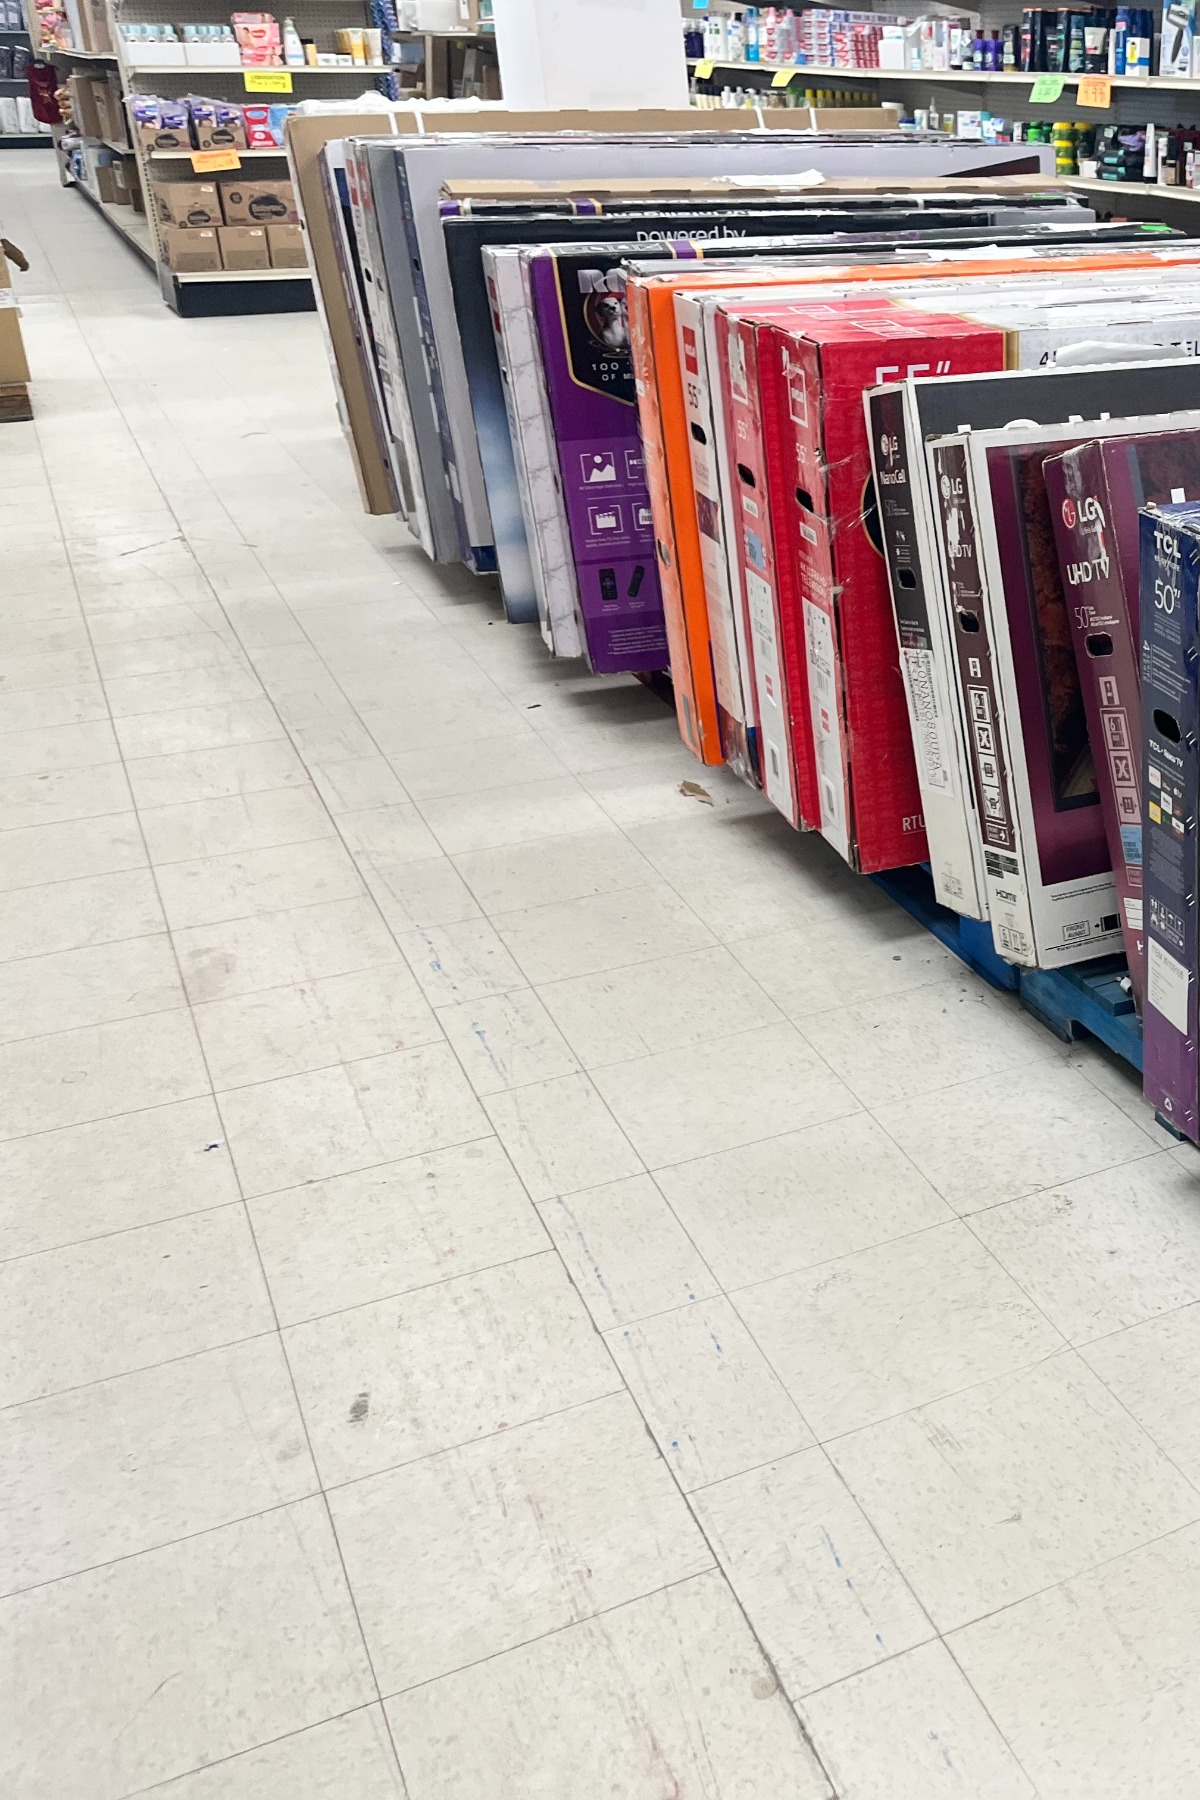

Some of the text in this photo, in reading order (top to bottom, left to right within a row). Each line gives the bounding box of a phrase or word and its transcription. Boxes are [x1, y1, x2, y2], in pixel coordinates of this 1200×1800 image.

[880, 468, 906, 484] NanoCell
[952, 478, 963, 494] LG
[1077, 498, 1097, 522] LG
[1153, 531, 1181, 558] TCL
[1067, 556, 1109, 585] UHD TV
[1154, 579, 1180, 614] 50"
